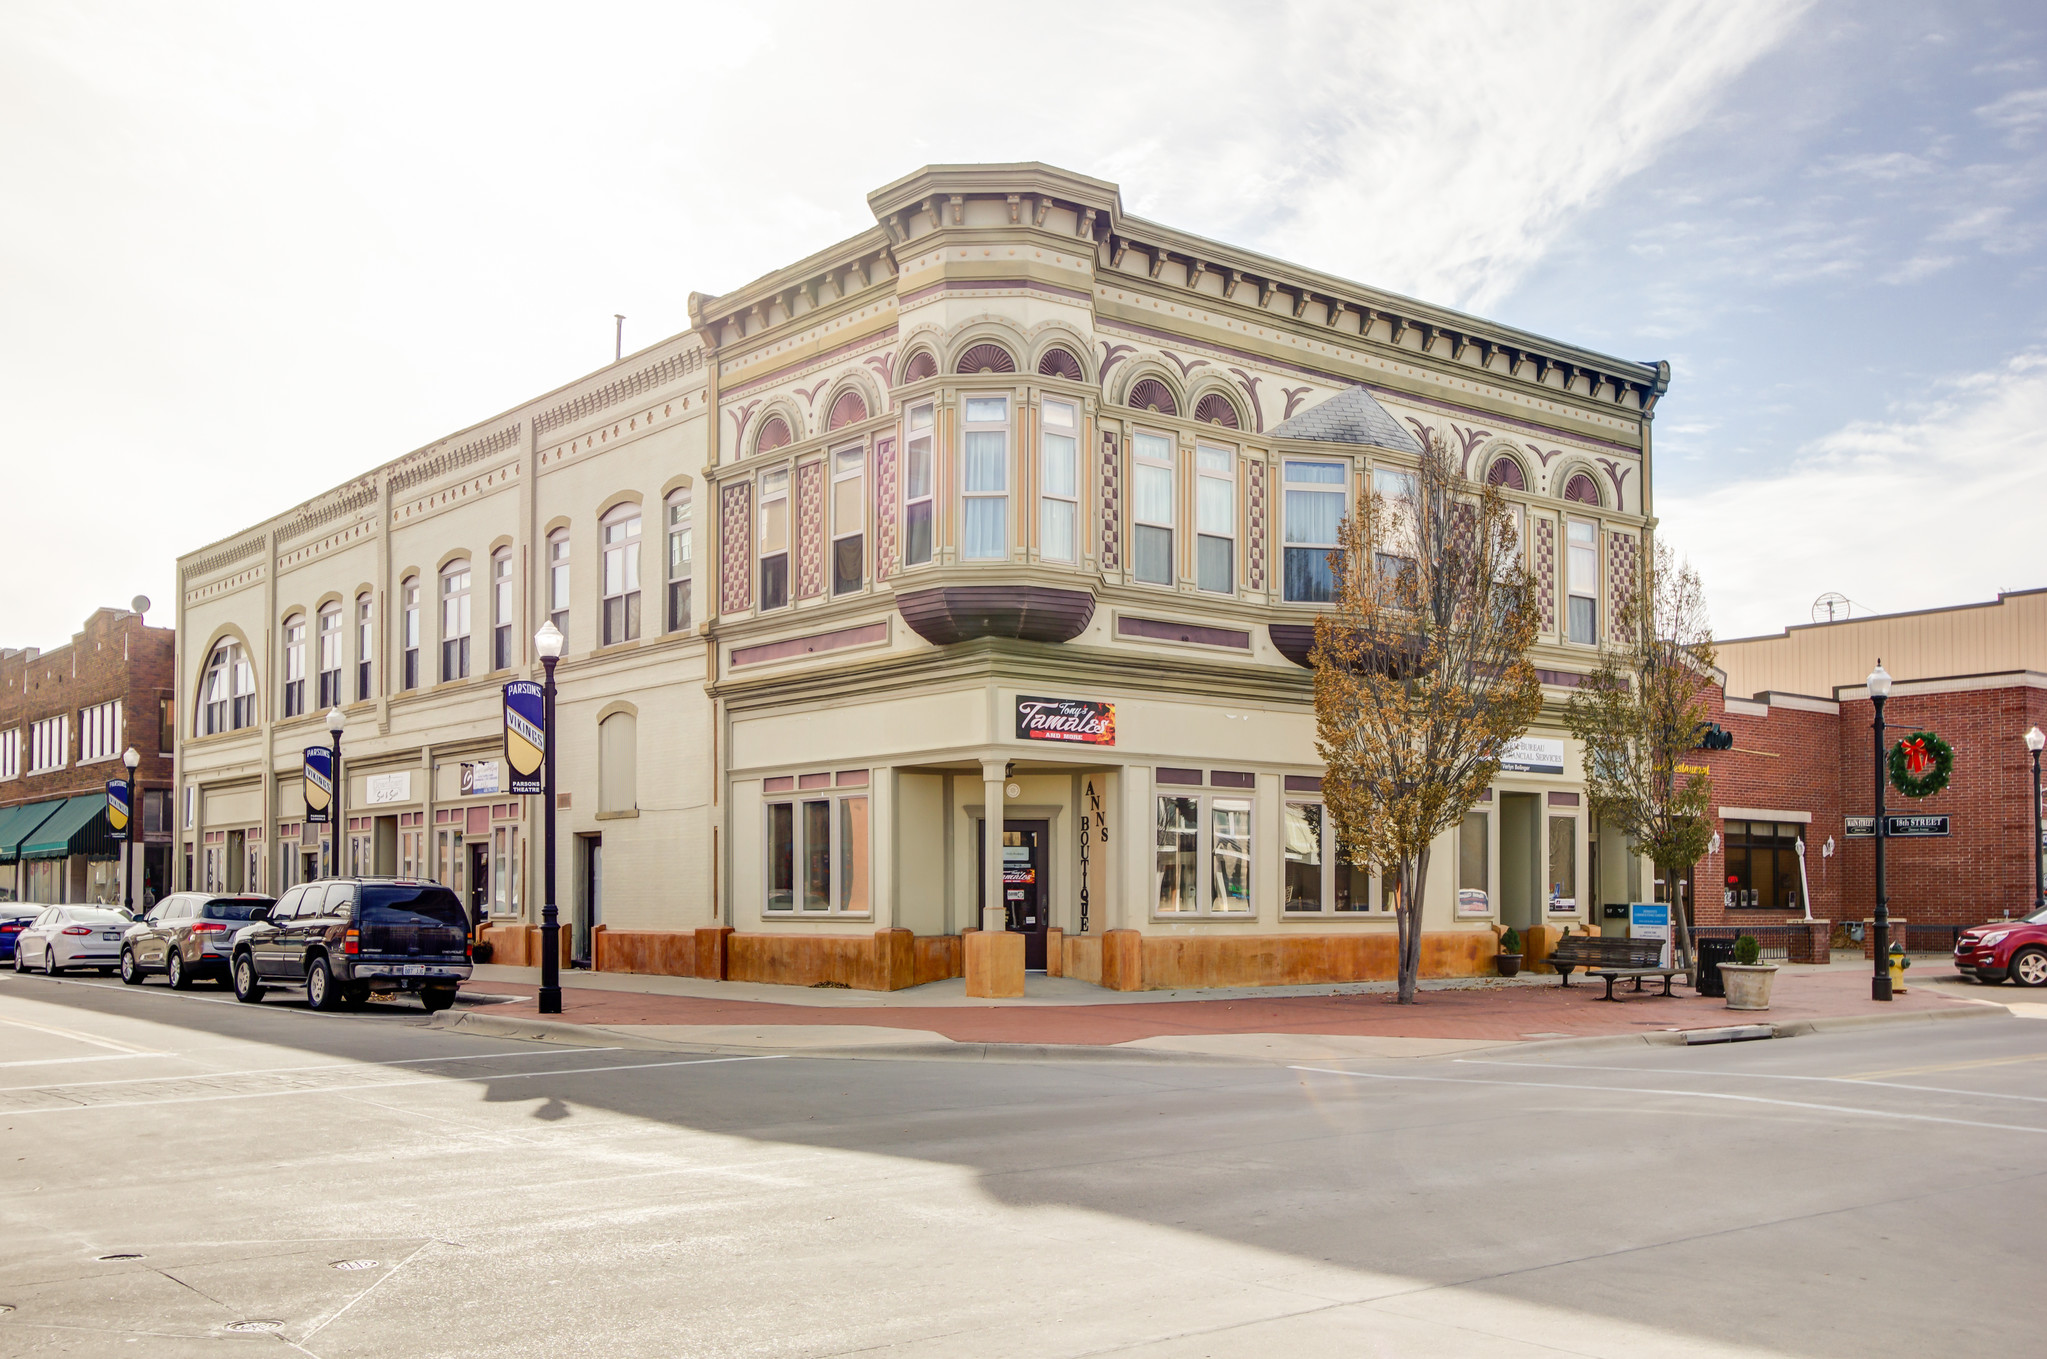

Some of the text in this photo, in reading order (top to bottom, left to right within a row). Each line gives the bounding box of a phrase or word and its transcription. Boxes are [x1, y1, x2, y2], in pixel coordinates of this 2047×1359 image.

[508, 683, 541, 698] PARSONS
[1018, 701, 1110, 734] Tamales
[1059, 702, 1089, 718] Tony's
[508, 711, 543, 747] VIKINGS
[306, 748, 331, 759] PARSONS
[1520, 742, 1545, 752] BUREAU
[1501, 752, 1562, 762] NANCIAL SERVICES
[307, 767, 331, 792] VIKINGS
[1858, 819, 1874, 827] STREET
[1896, 818, 1943, 827] 18th STREET
[1080, 816, 1090, 932] BOUTIQUE
